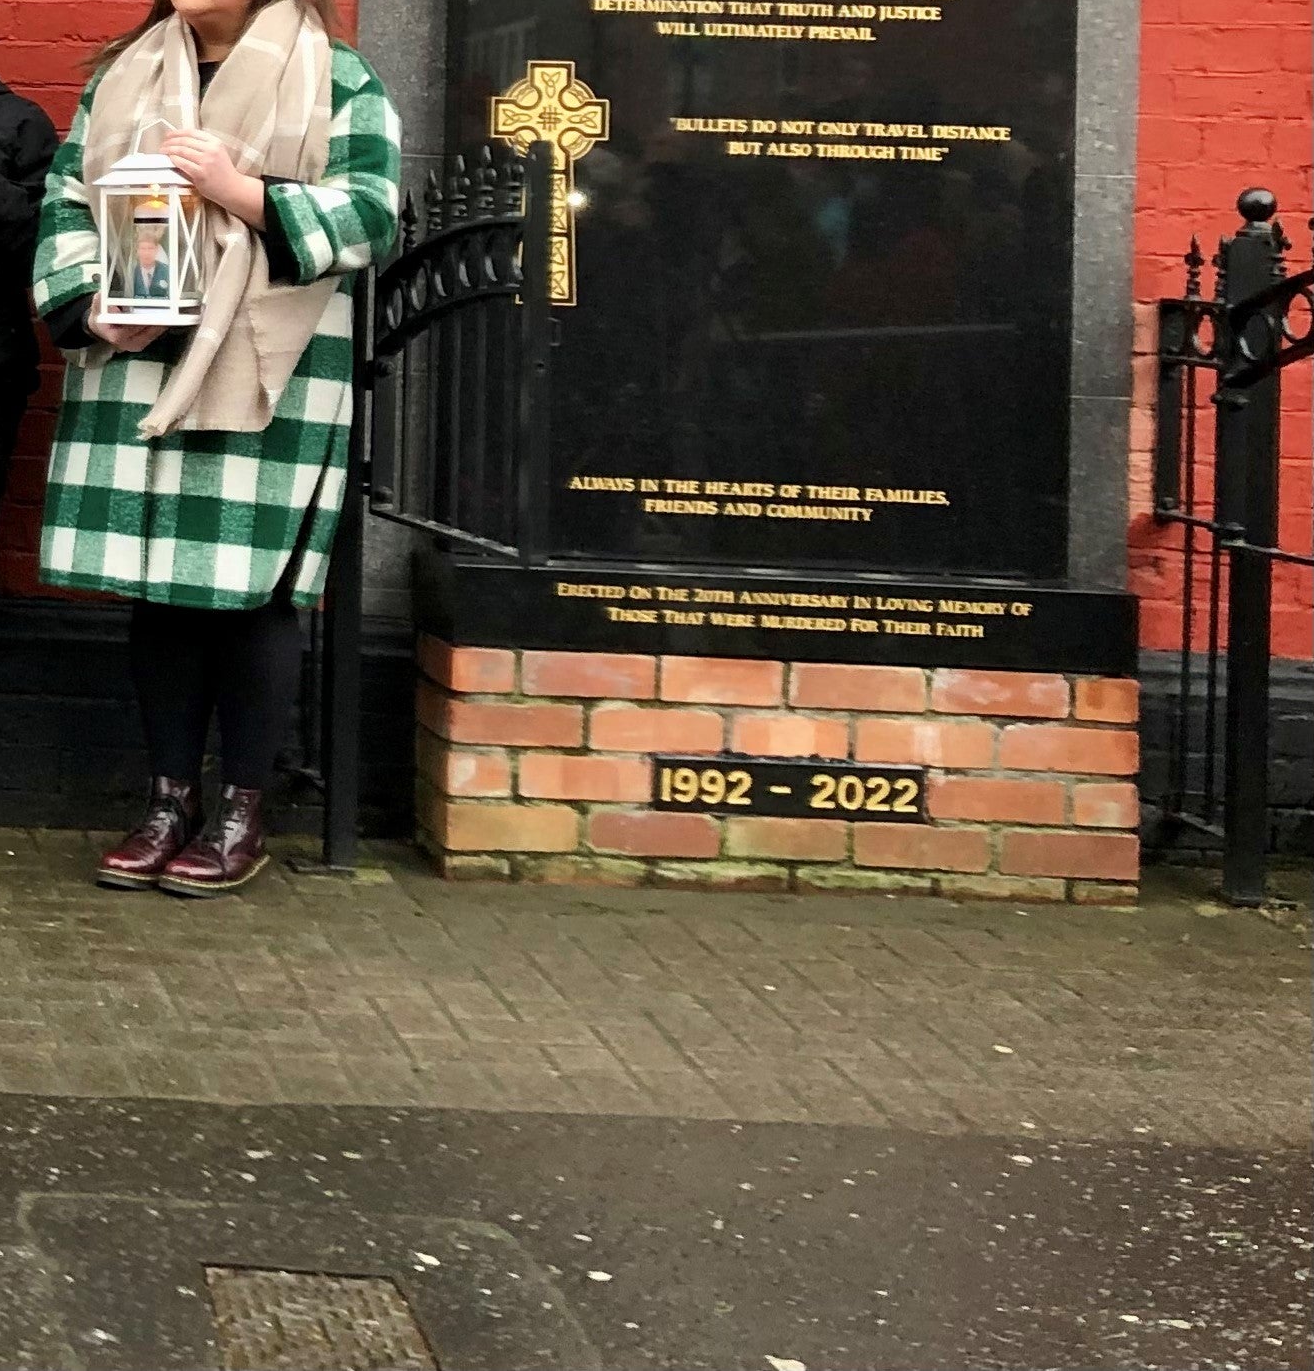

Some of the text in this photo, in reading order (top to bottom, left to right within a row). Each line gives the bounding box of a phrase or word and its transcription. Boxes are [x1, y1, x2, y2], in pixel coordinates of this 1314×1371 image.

[751, 119, 777, 133] DO
[779, 120, 815, 135] NOT
[817, 121, 861, 136] ONLY
[861, 122, 928, 138] TRAVEL
[931, 124, 1011, 141] DISTANCE
[727, 141, 763, 155] BUT
[766, 142, 813, 156] ALSO
[814, 143, 895, 159] THROUGH
[569, 476, 635, 492] ALWAYS
[640, 478, 659, 492] IN
[662, 479, 700, 494] THE
[704, 481, 775, 497] HEARTS
[779, 484, 802, 498] OF
[805, 485, 860, 501] THEIR
[644, 498, 873, 521] FRIENDS AND COMMUNITY
[660, 767, 752, 805] 1992
[809, 773, 918, 813] 2022
